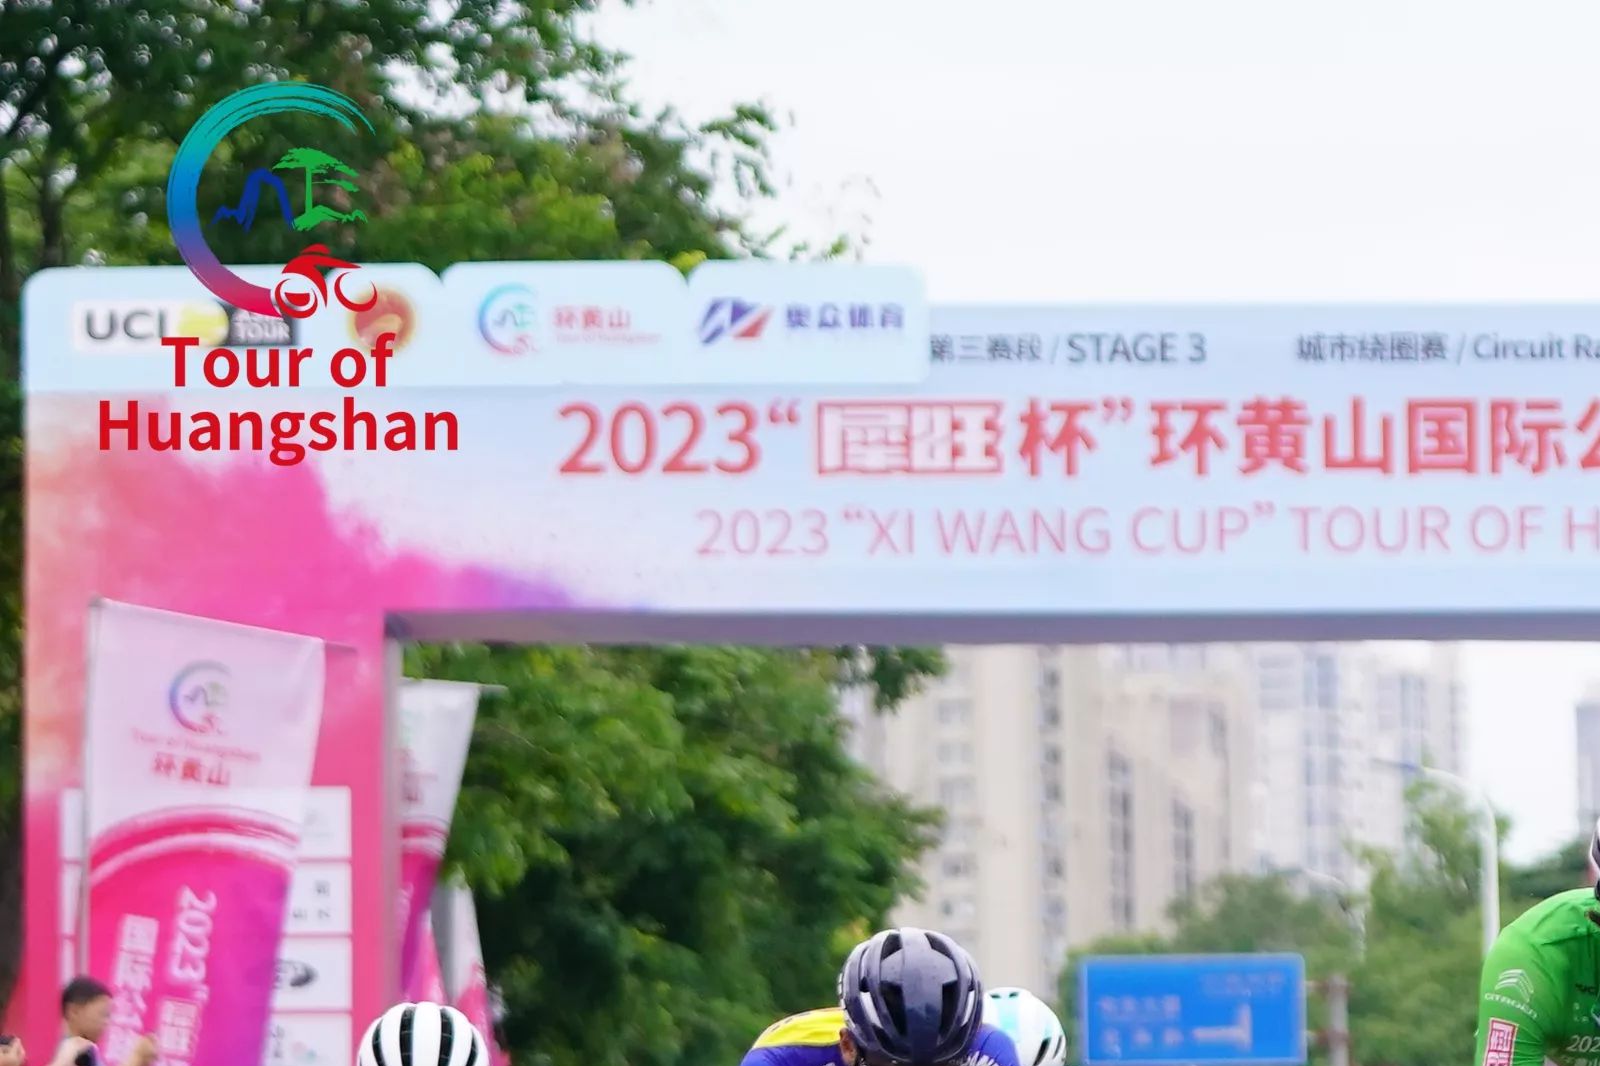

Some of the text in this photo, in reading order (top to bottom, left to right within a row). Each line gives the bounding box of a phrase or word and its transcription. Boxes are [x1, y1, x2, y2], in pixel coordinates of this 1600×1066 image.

[86, 309, 166, 341] UCI
[1067, 333, 1178, 363] STAGE
[1187, 333, 1208, 363] 3
[1473, 332, 1566, 361] Circuit
[695, 509, 829, 556] 2023
[936, 507, 1111, 555] WANG
[1288, 504, 1451, 553] TOUR
[1470, 504, 1544, 553] OF
